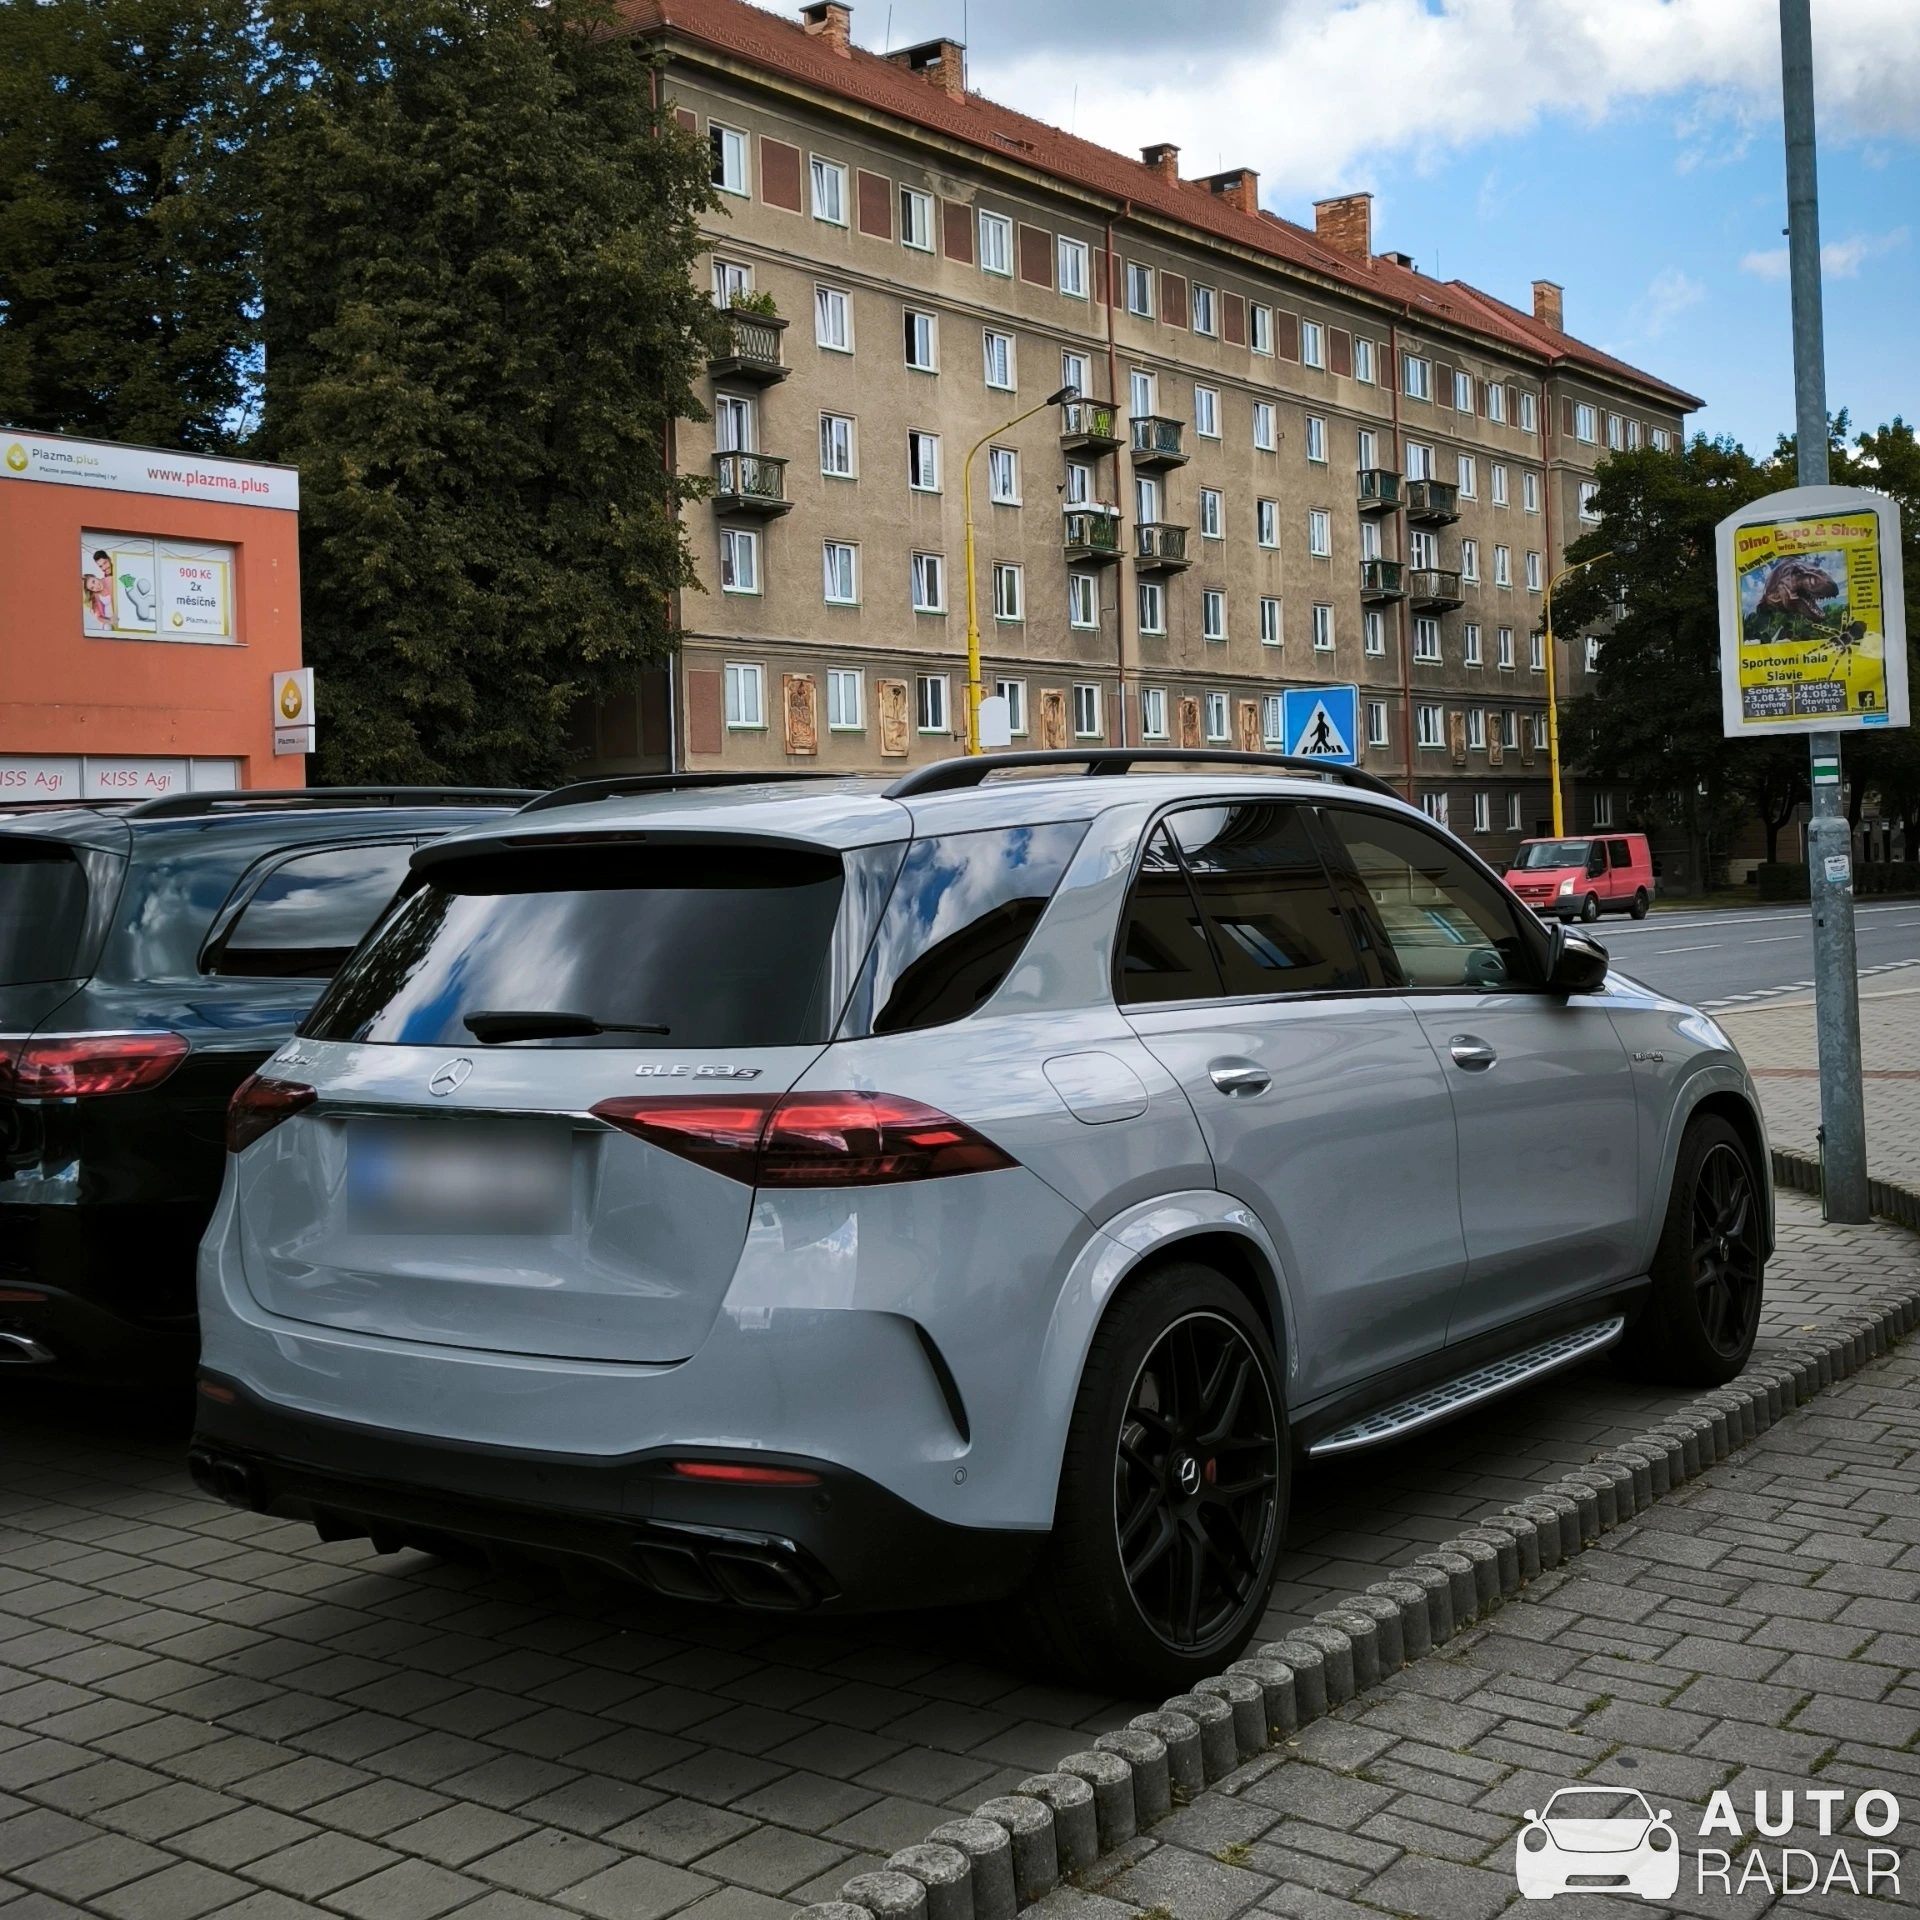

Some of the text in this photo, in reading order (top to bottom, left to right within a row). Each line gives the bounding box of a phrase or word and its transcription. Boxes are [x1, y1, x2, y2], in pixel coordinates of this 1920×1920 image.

[32, 448, 99, 466] Plazma.plus
[147, 467, 270, 494] www.plazma.plus
[1738, 523, 1873, 552] Dino Expo & Show
[179, 567, 212, 580] 900 Kč
[190, 581, 202, 592] 2x
[176, 595, 217, 608] měsíčně
[1742, 653, 1799, 670] Sportovní
[1747, 686, 1788, 695] Sobota
[1794, 688, 1847, 700] 24.08.25
[1744, 692, 1793, 704] 23.08.25
[0, 769, 65, 791] ISS Agi
[100, 769, 174, 791] KISS Agi
[635, 1064, 691, 1077] GLE
